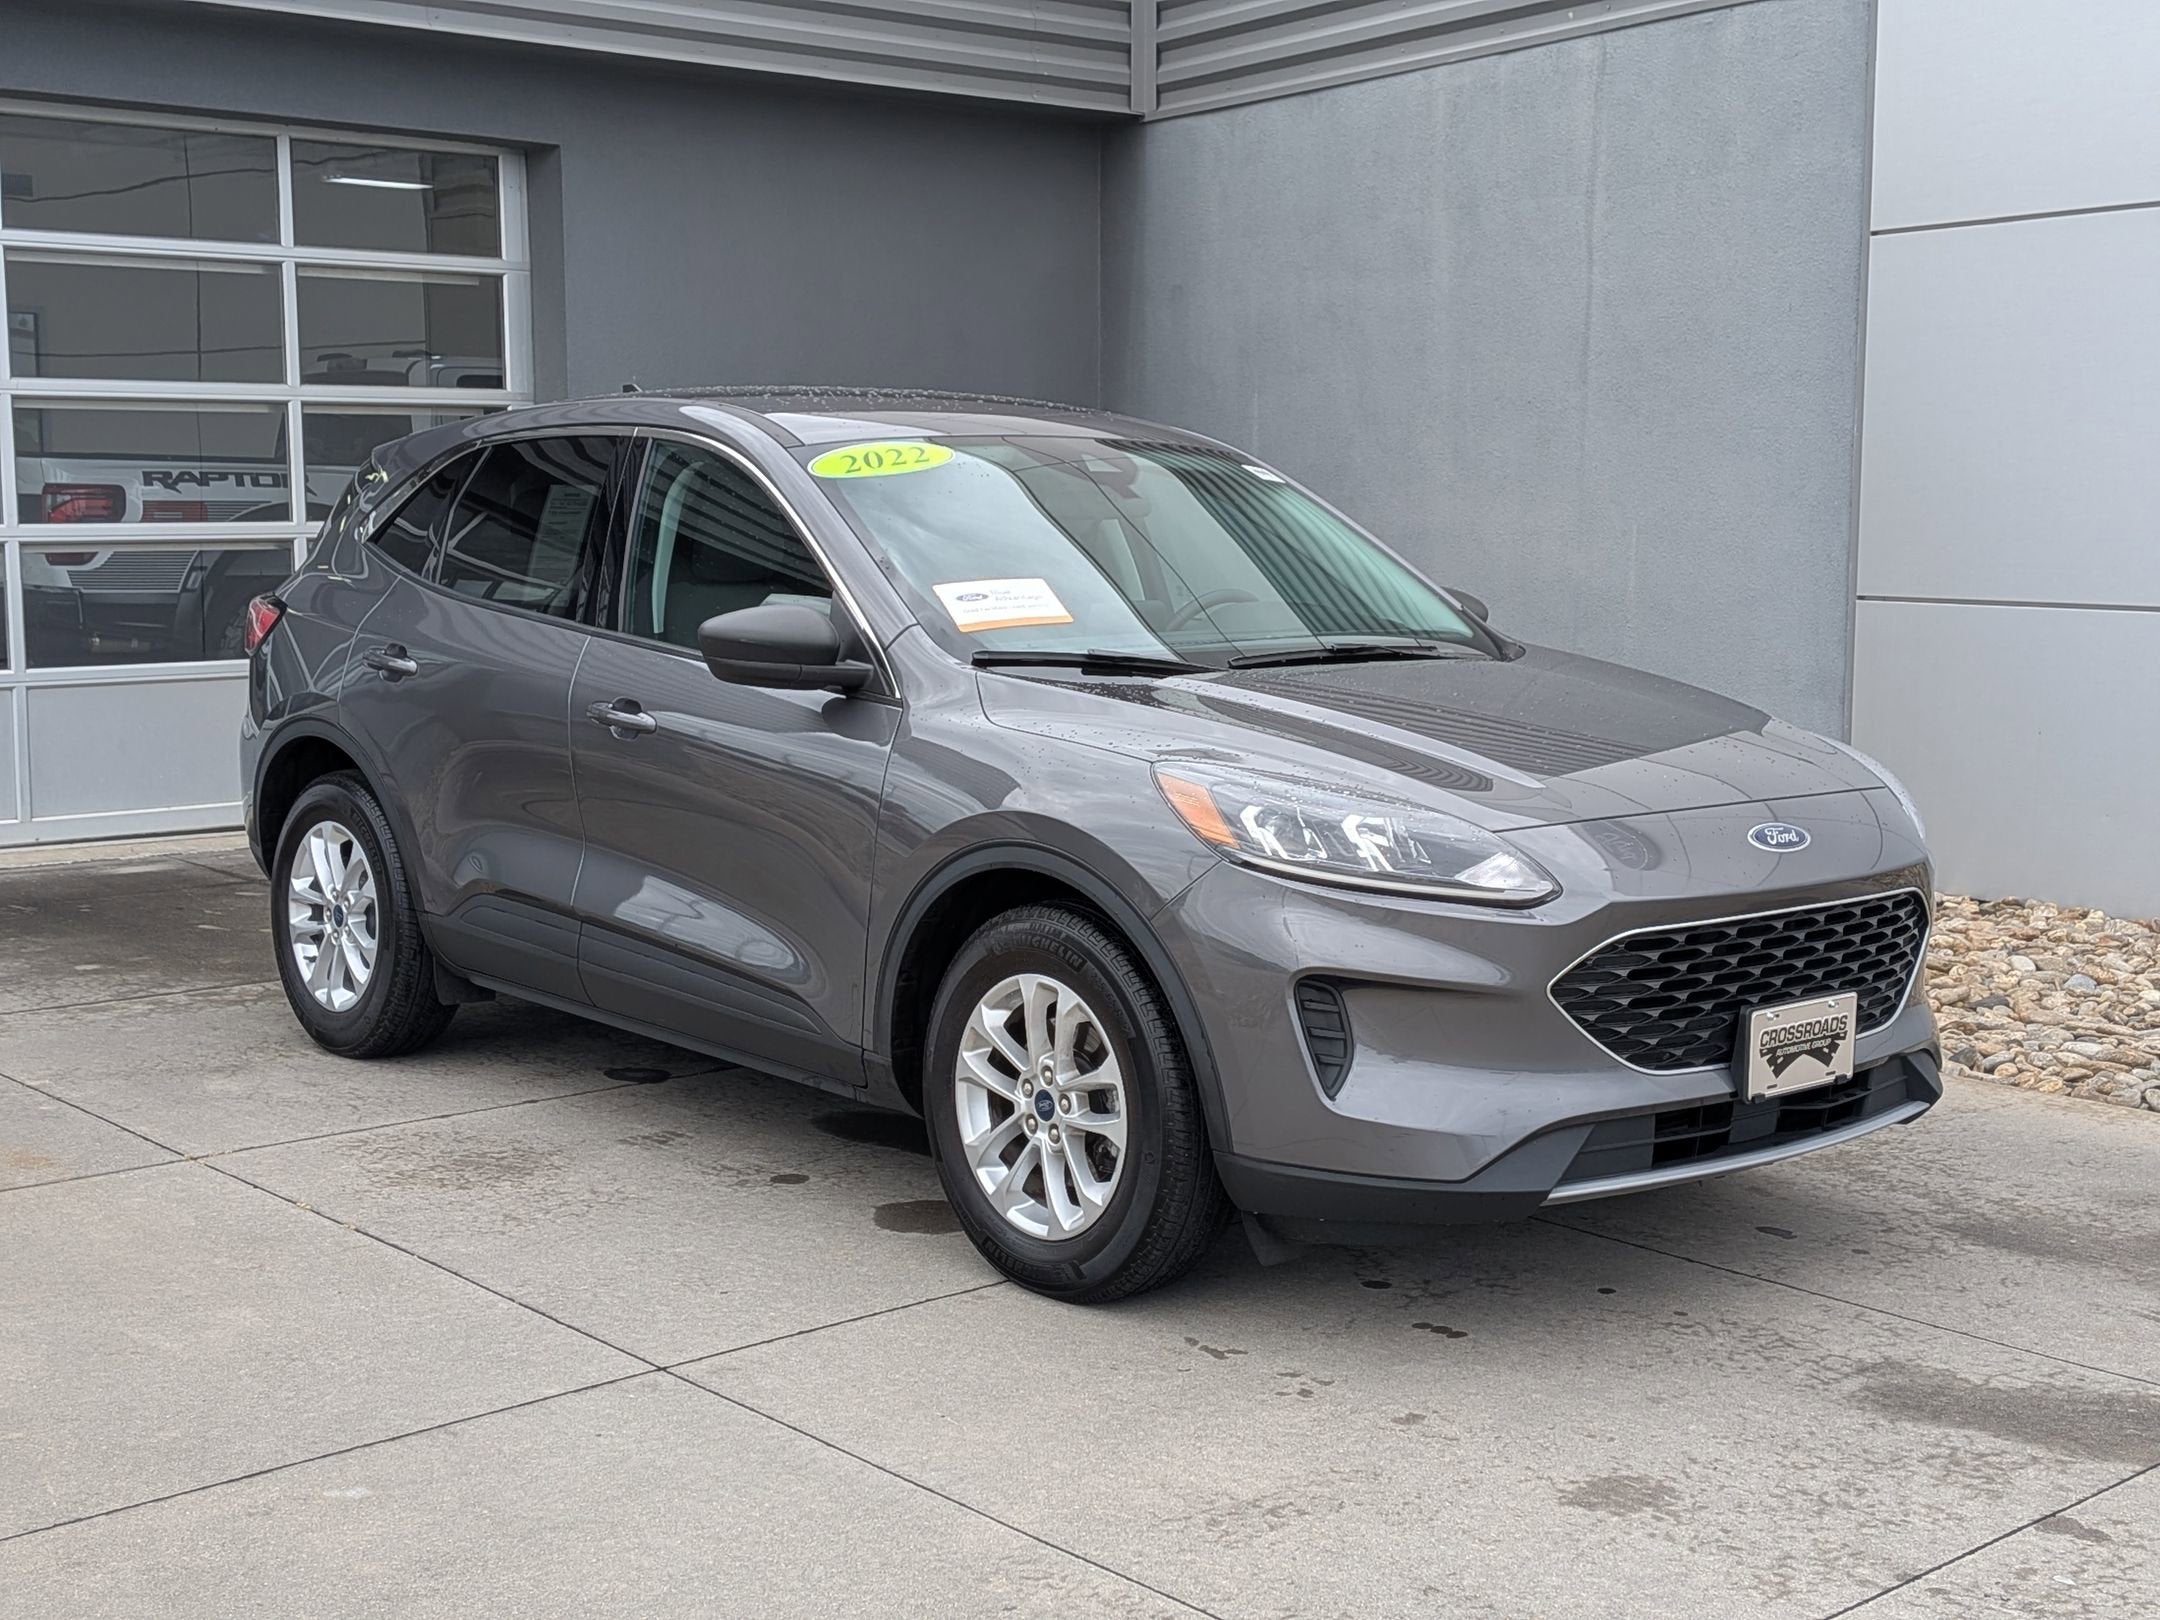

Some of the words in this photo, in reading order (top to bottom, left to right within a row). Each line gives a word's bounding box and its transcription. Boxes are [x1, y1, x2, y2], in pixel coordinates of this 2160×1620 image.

[840, 446, 930, 473] 2022
[1764, 827, 1800, 845] Ford
[1760, 1013, 1848, 1047] CROSSROADS
